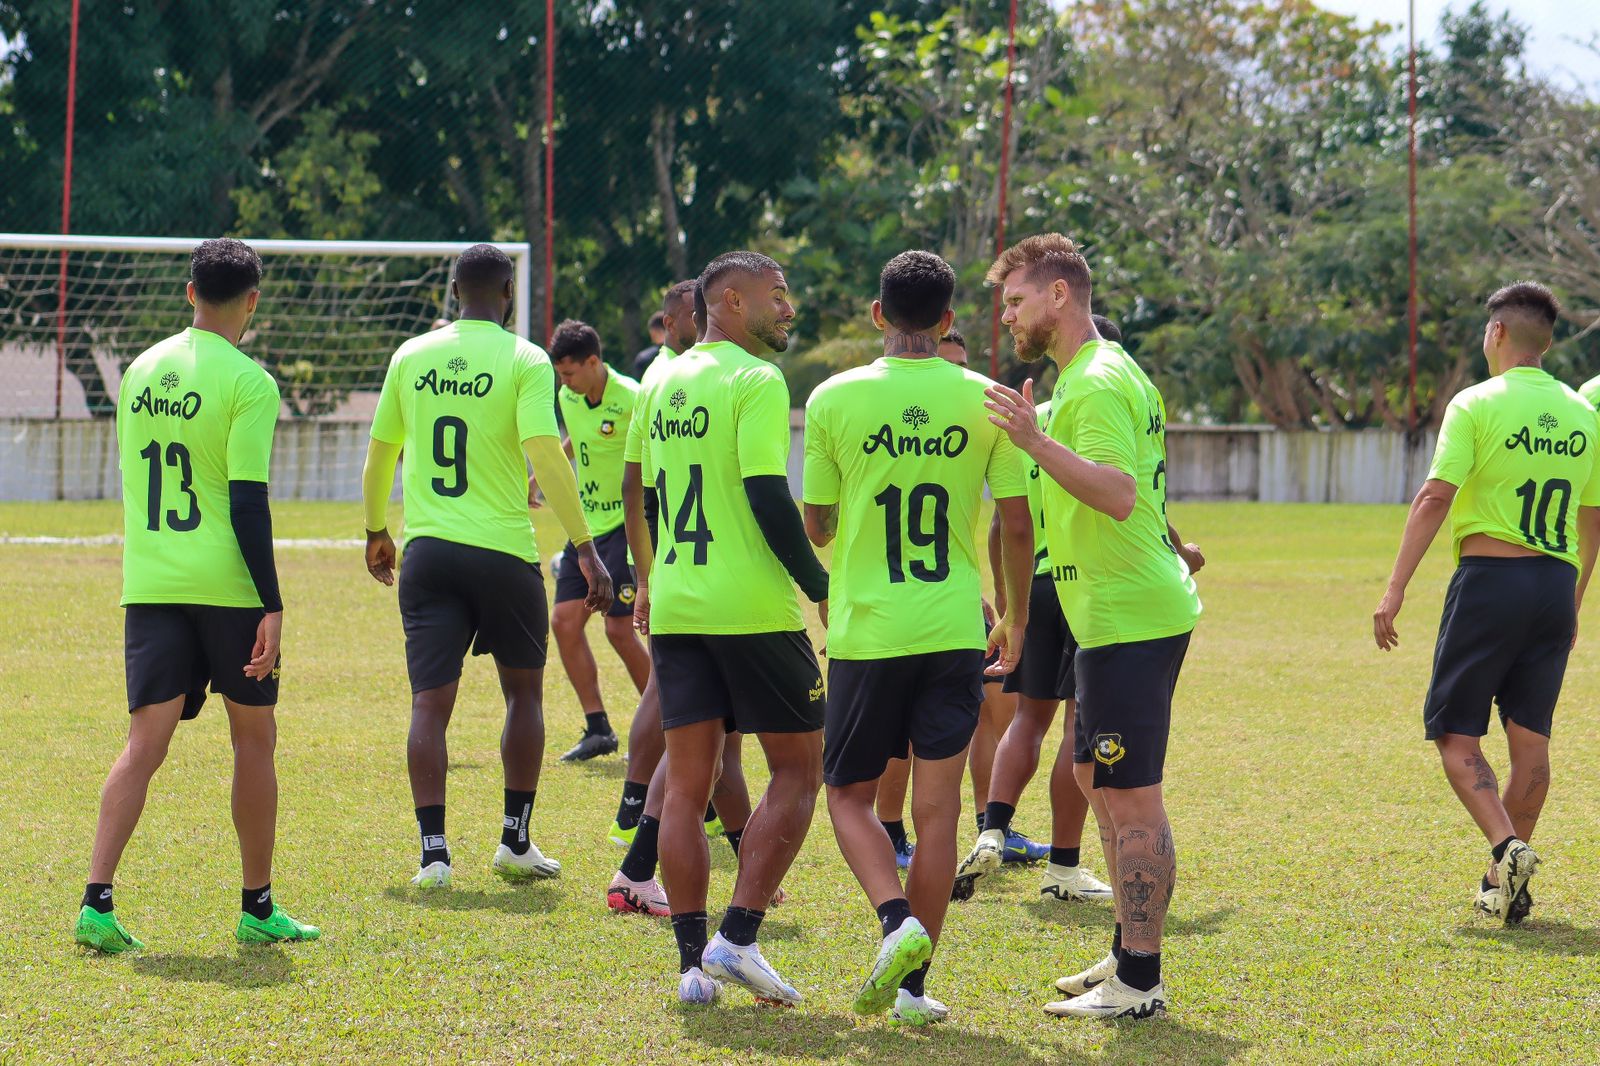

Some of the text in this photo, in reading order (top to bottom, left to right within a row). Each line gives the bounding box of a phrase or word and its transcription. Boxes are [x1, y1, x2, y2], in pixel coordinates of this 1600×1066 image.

[415, 368, 494, 398] AmaO
[131, 386, 202, 420] AmaO
[650, 405, 710, 442] AmaO
[863, 423, 969, 458] AmaO
[1505, 426, 1587, 458] AmaO
[431, 415, 469, 498] 9
[580, 442, 590, 467] 6
[140, 439, 202, 532] 13
[655, 464, 714, 566] 14
[874, 483, 950, 584] 19
[1515, 478, 1572, 553] 10
